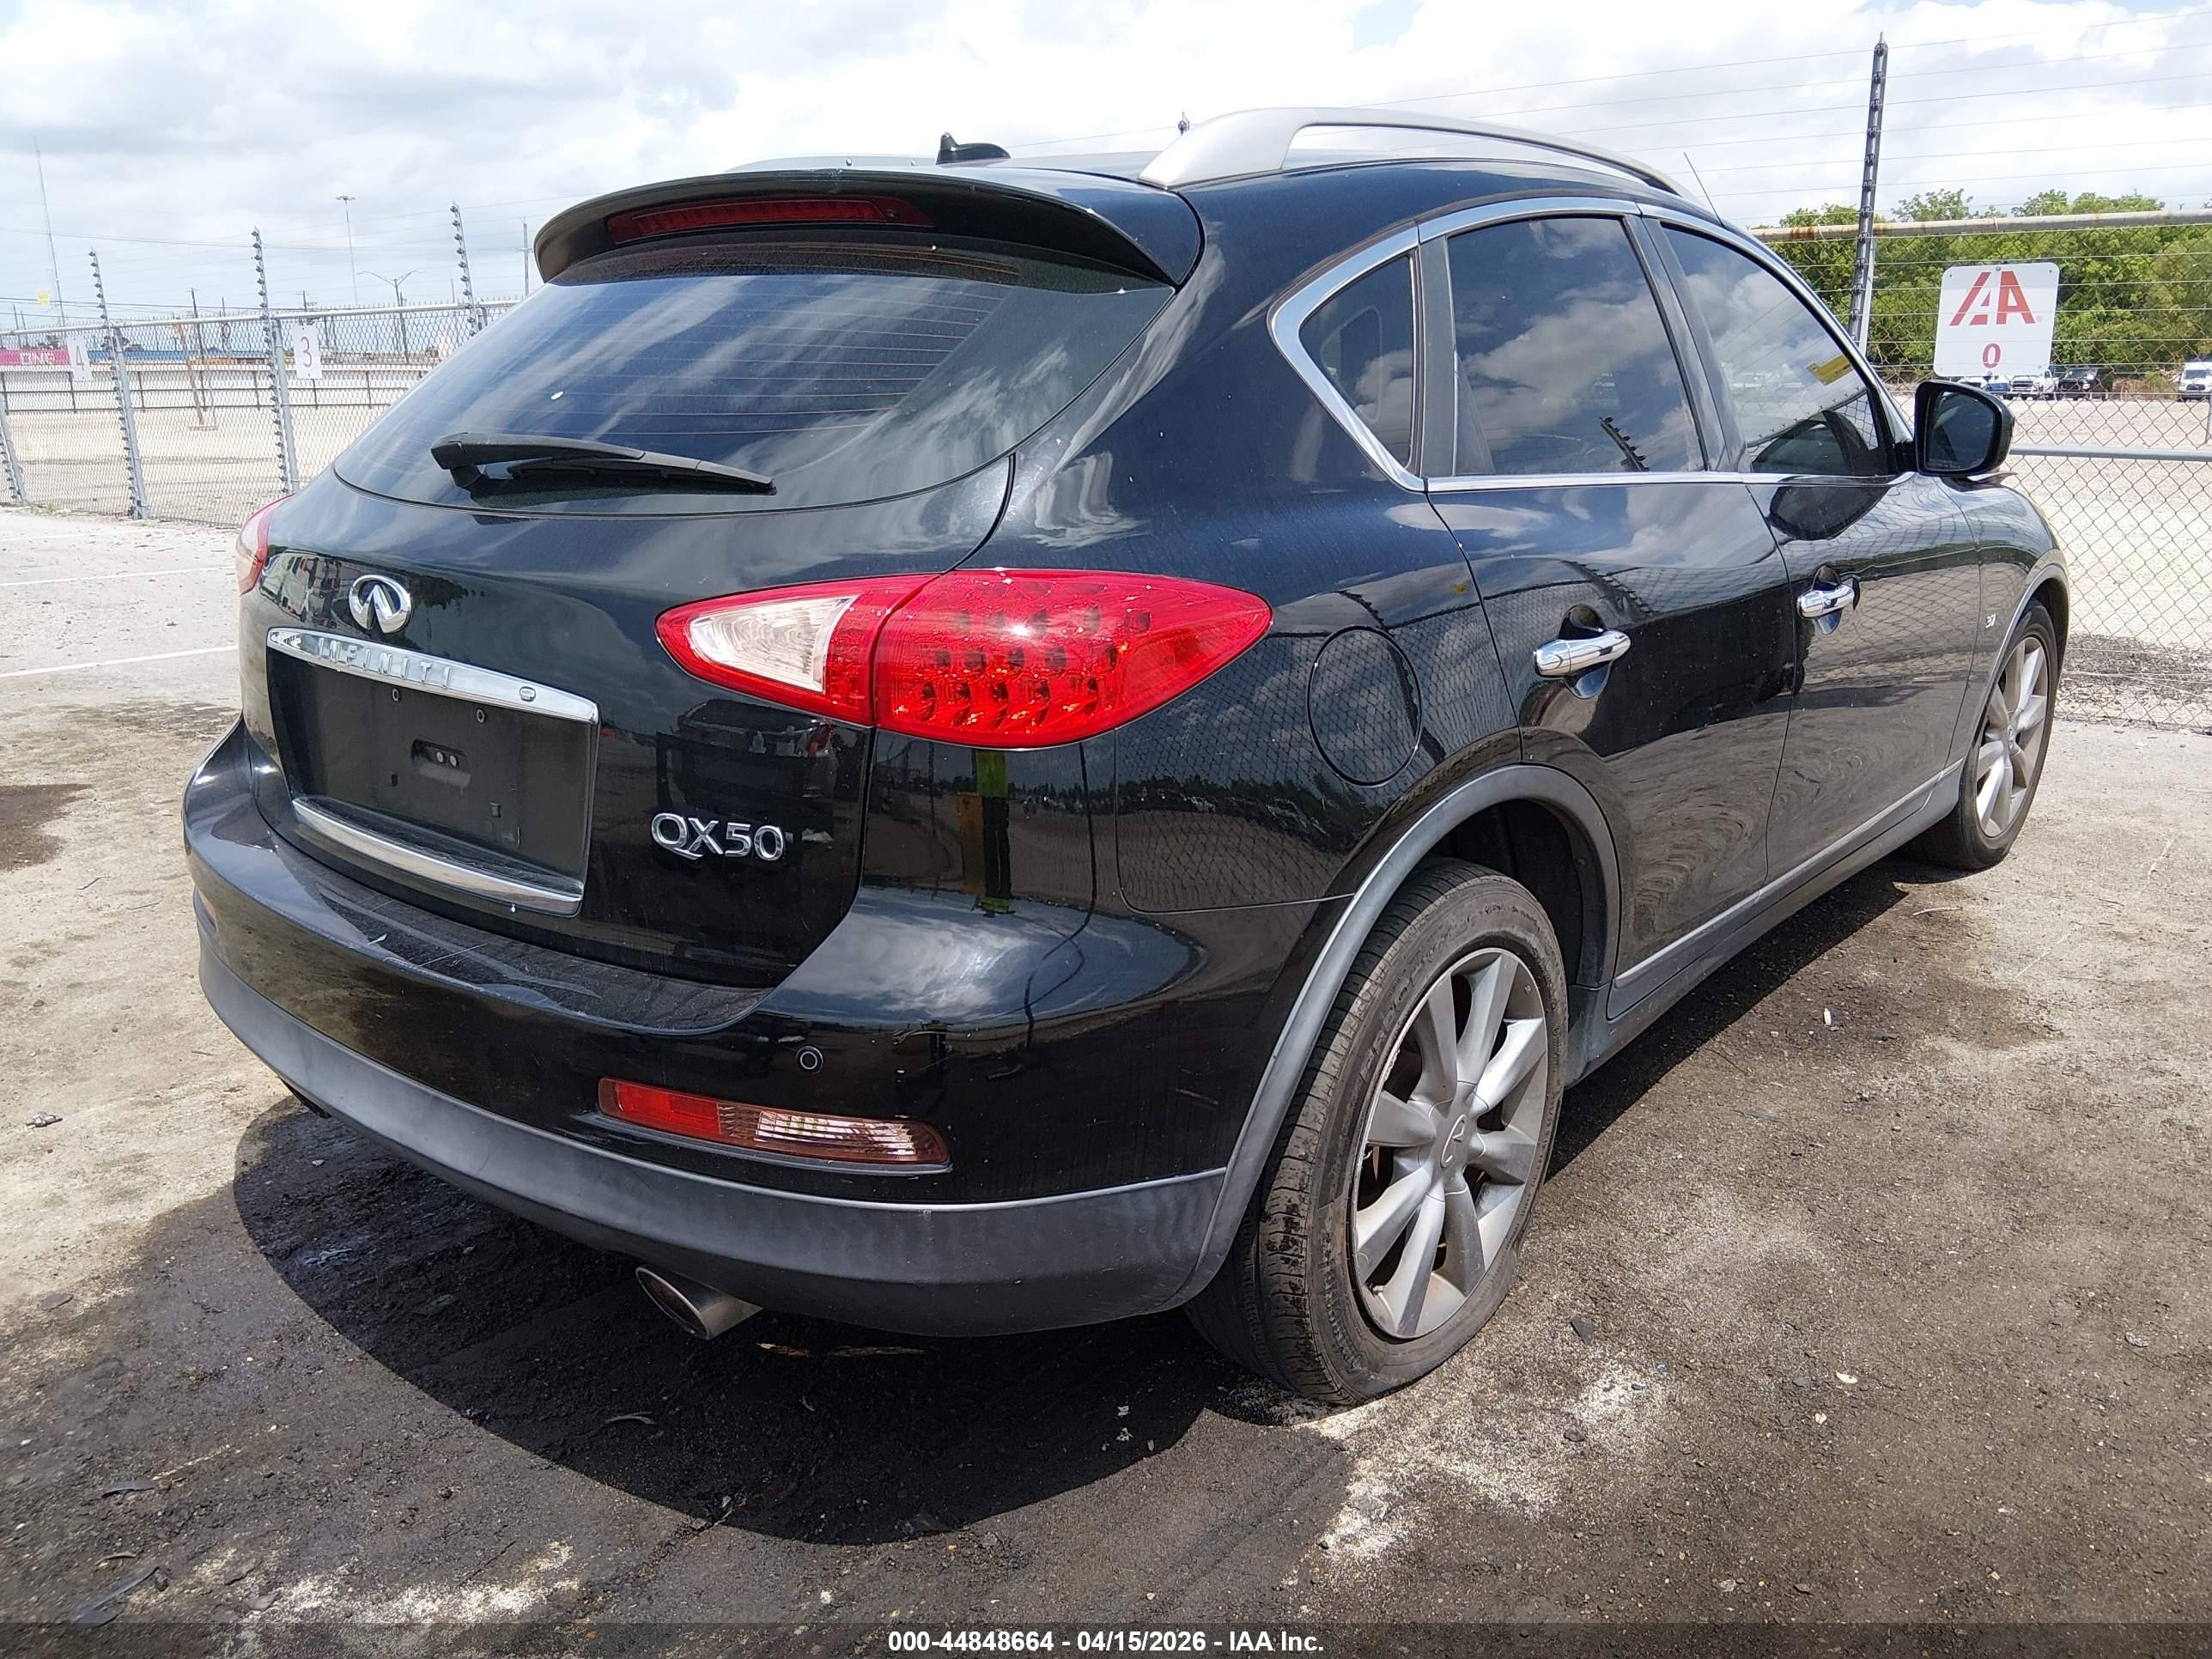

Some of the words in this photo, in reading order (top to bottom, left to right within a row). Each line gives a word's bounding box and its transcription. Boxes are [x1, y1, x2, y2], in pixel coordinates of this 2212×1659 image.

[76, 345, 85, 371] 4
[301, 336, 313, 368] 3
[1982, 343, 2002, 368] 0
[316, 636, 453, 689] INFINITI
[650, 811, 785, 862] QX50
